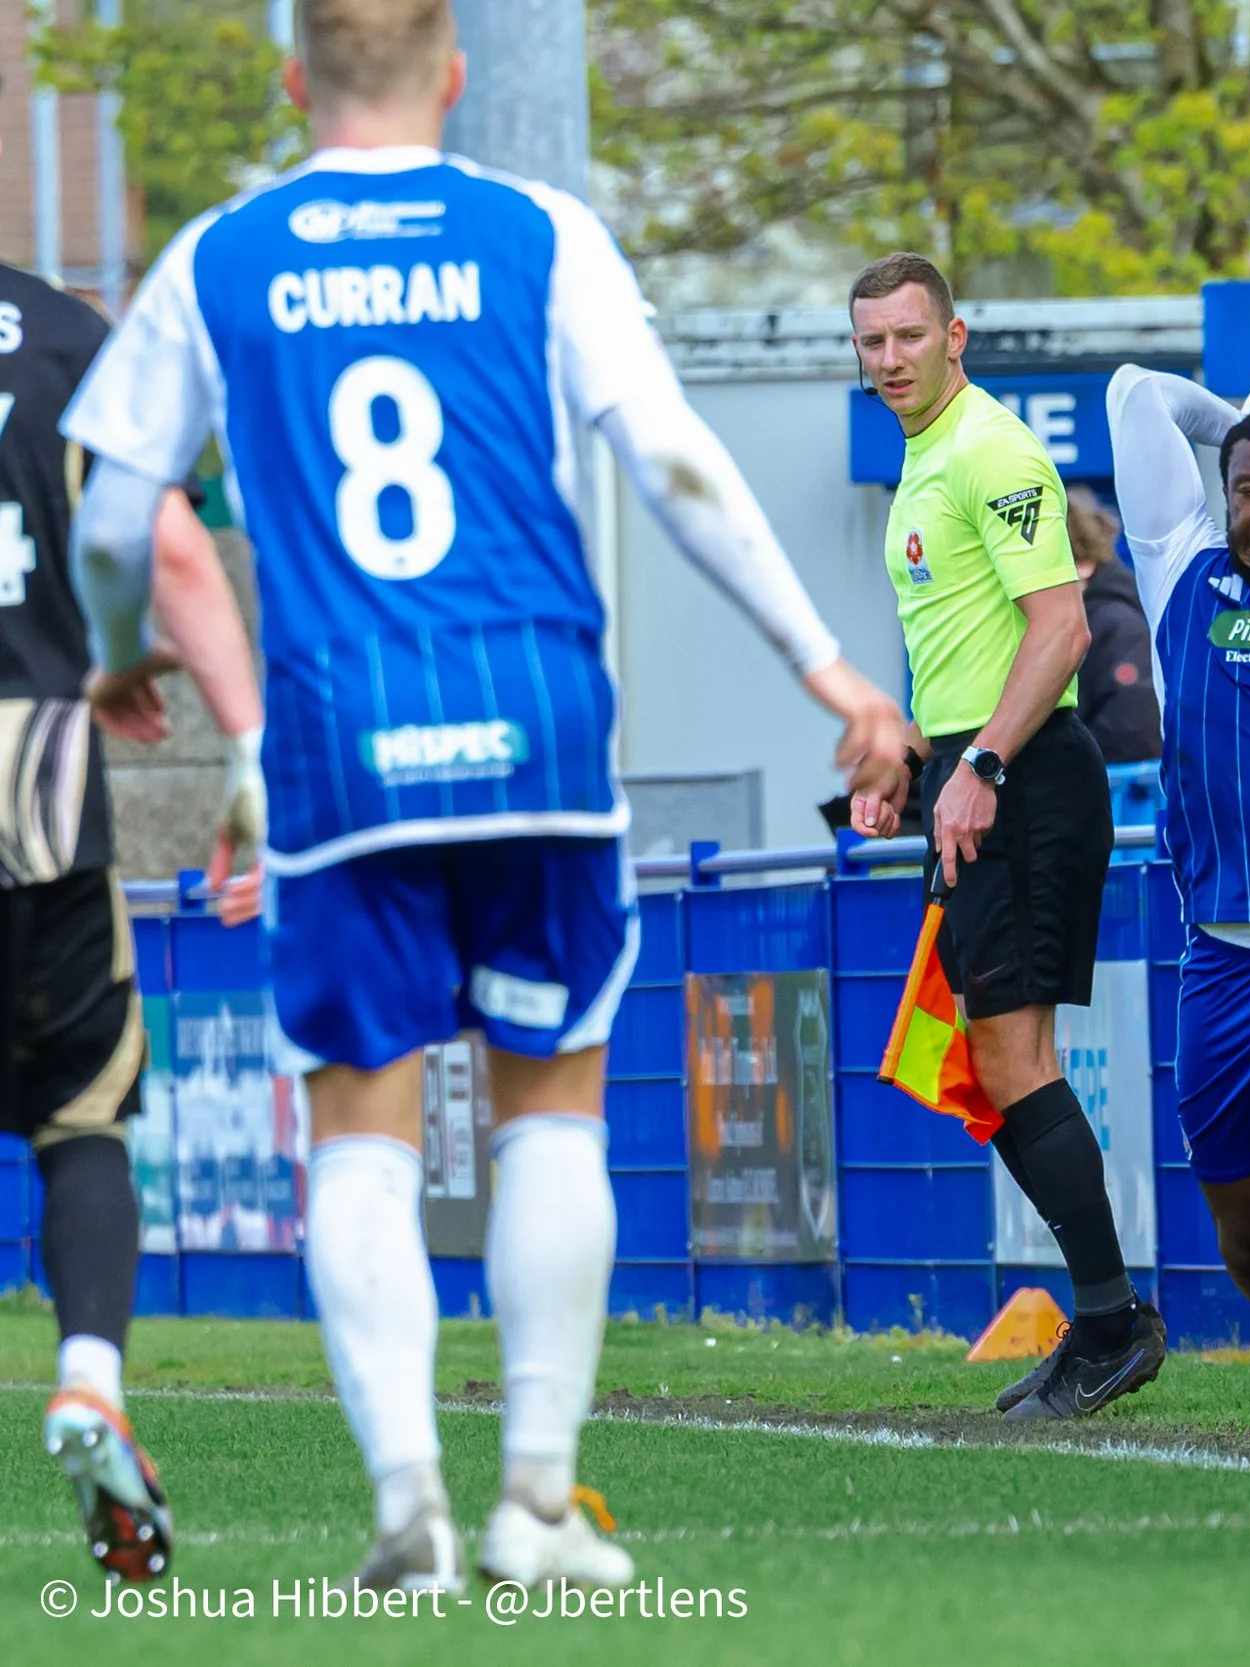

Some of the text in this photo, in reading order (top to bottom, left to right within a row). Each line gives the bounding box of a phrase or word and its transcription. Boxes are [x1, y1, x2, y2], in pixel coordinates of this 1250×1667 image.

[268, 261, 481, 333] CURRAN
[329, 355, 456, 580] 8
[1008, 488, 1037, 504] SPORTS
